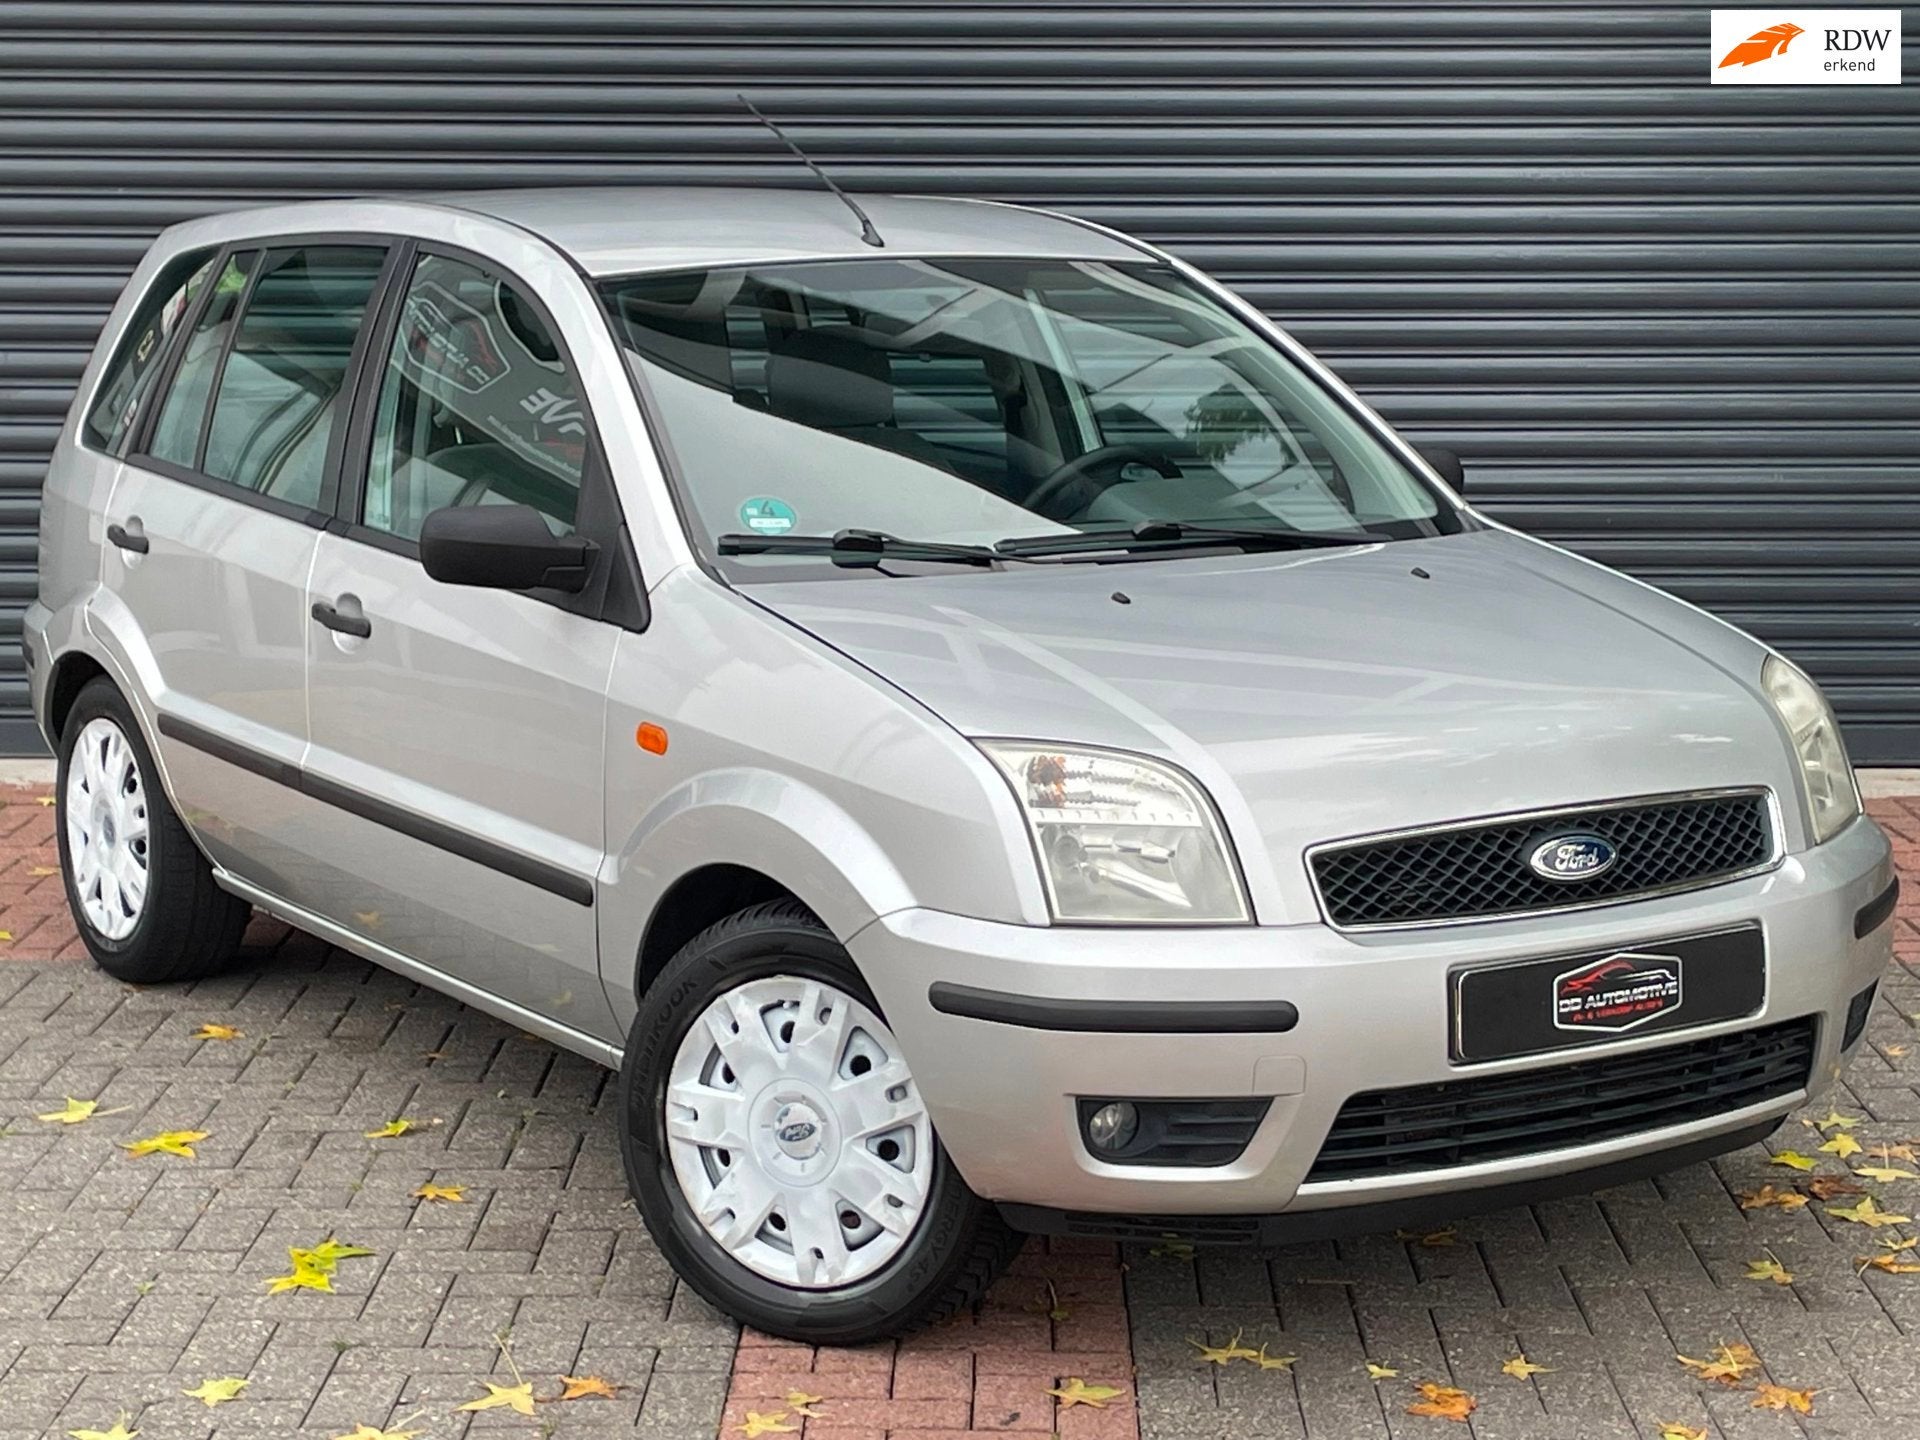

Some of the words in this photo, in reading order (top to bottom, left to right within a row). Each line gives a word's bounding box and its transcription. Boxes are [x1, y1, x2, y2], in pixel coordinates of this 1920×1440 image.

[757, 499, 775, 516] 4
[1555, 844, 1599, 871] Ford
[1584, 981, 1678, 1010] AUTOMOTIVE
